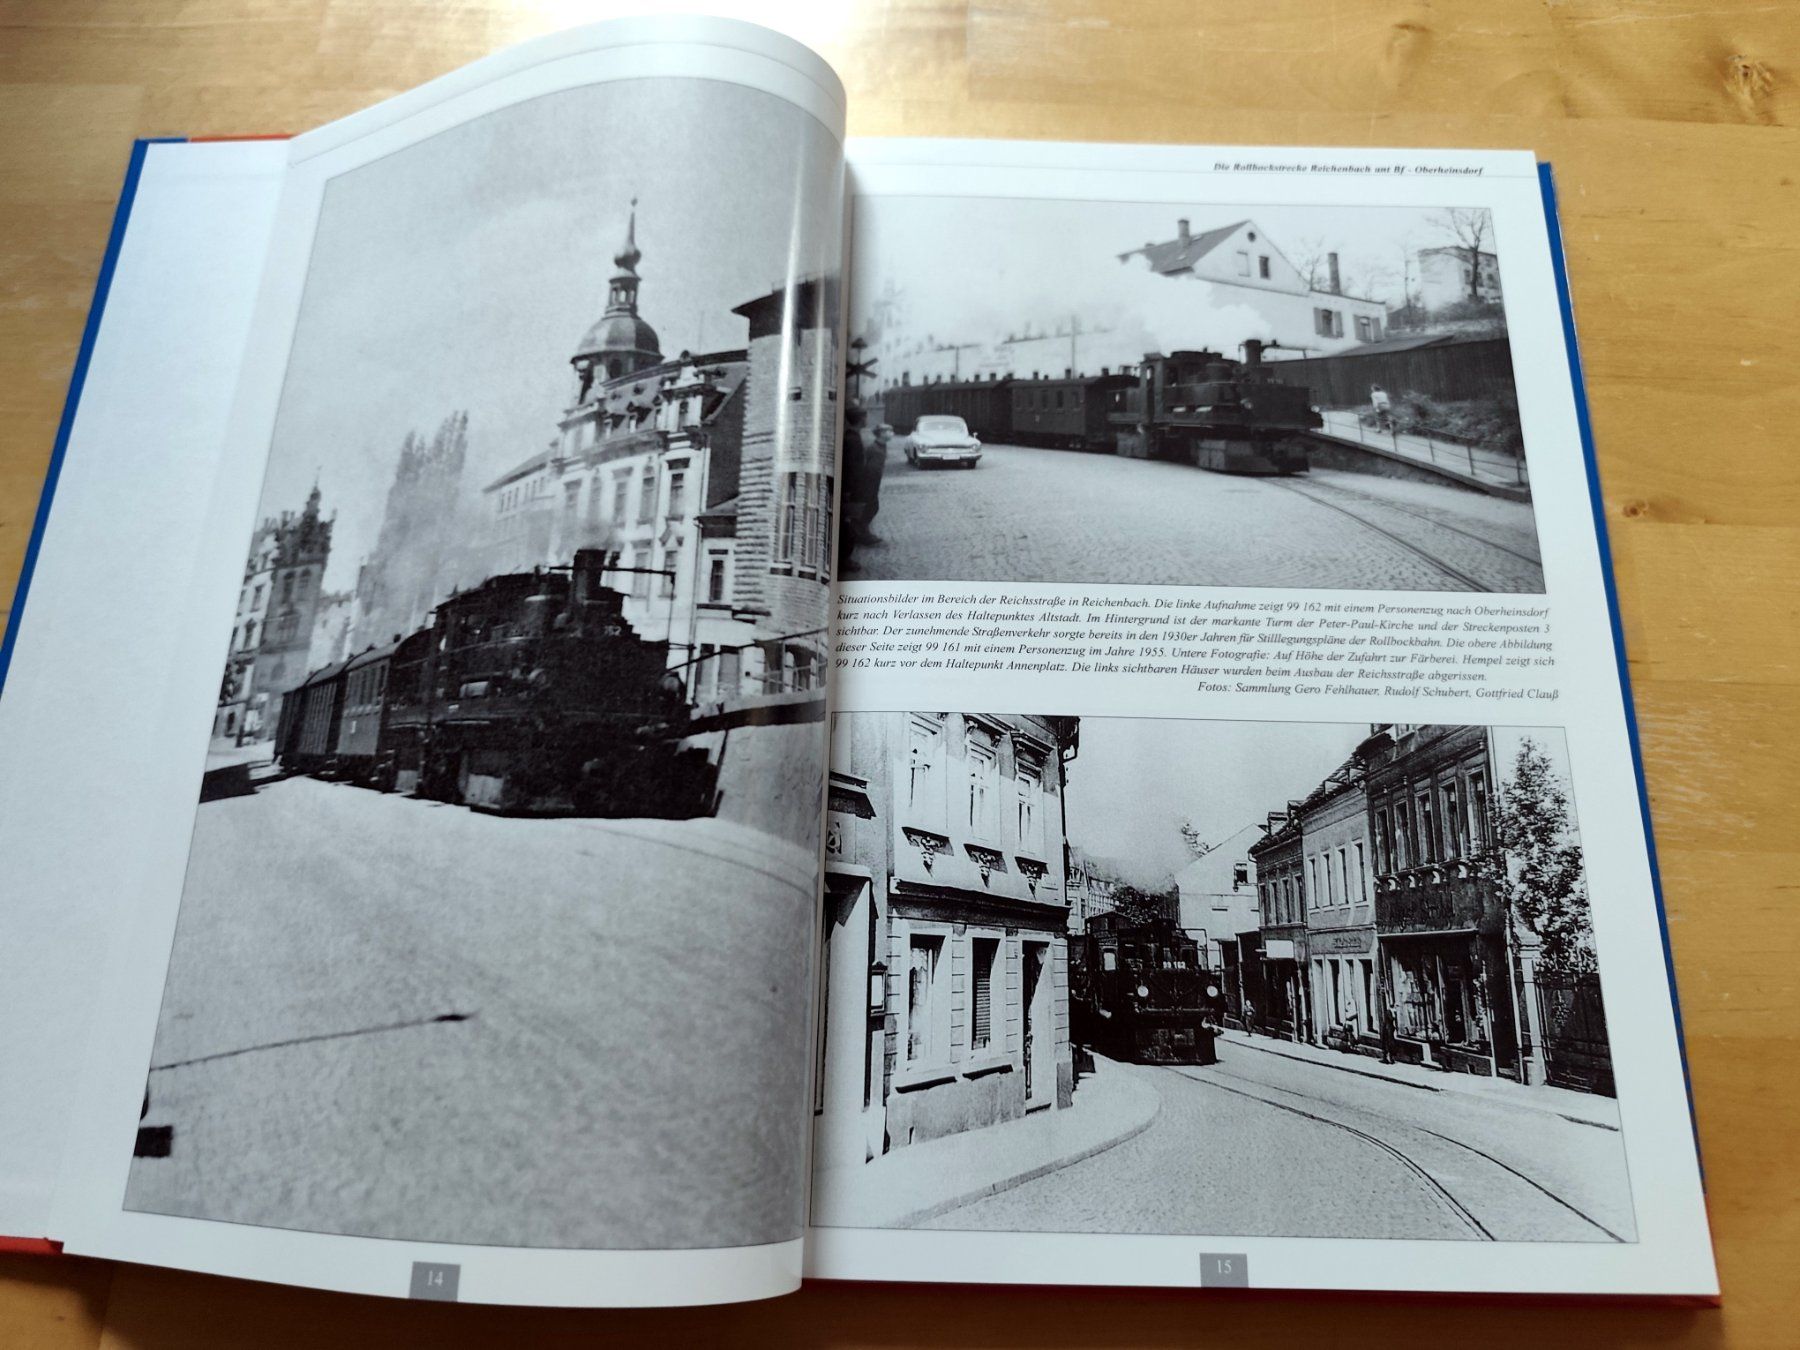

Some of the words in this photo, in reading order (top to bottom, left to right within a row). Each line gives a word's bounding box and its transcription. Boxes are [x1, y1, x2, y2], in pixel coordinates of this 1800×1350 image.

[1213, 162, 1230, 171] Die
[1233, 163, 1307, 172] Rollbockstrecke
[1310, 164, 1371, 172] Reichenbach
[1393, 165, 1405, 174] Bf
[1414, 166, 1483, 175] Oberheinsdorf
[837, 593, 918, 604] Situationsbilder
[921, 594, 934, 603] im
[937, 594, 976, 604] Bereich
[978, 594, 996, 604] der
[999, 595, 1065, 607] Reichsstraße
[1068, 597, 1079, 606] in
[1081, 597, 1150, 607] Reichenbach.
[1154, 598, 1173, 608] Die
[1175, 599, 1201, 609] linke
[1203, 600, 1256, 611] Aufnahme
[1258, 602, 1284, 613] zeigt
[1286, 602, 1300, 610] 99
[1303, 602, 1322, 612] 162
[1324, 604, 1341, 612] mit
[1377, 604, 1443, 616] Personenzug
[1446, 606, 1471, 615] nach
[1474, 606, 1549, 617] Oberheinsdorf
[836, 610, 859, 620] kurz
[863, 609, 888, 619] nach
[893, 609, 941, 619] Verlassen
[945, 610, 963, 620] des
[967, 610, 1034, 622] Haltepunktes
[1038, 612, 1081, 622] Altstadt.
[1086, 613, 1100, 622] Im
[1104, 613, 1170, 625] Hintergrund
[1173, 615, 1186, 624] ist
[1189, 615, 1208, 625] der
[1211, 617, 1261, 626] markante
[1266, 617, 1293, 627] Turm
[1296, 618, 1315, 628] der
[1318, 618, 1413, 630] Peter-Paul-Kirche
[1418, 621, 1438, 630] und
[1441, 621, 1459, 631] der
[1462, 622, 1539, 633] Streckenposten
[1544, 623, 1550, 634] 3
[835, 626, 878, 636] sichtbar.
[883, 625, 903, 635] Der
[905, 626, 969, 636] zunehmende
[972, 626, 1050, 638] Straßenverkehr
[1052, 631, 1085, 640] sorgte
[1088, 629, 1122, 639] bereits
[1126, 630, 1136, 640] in
[1138, 630, 1158, 640] den
[1162, 631, 1198, 641] 1930er
[1199, 632, 1236, 642] Jahren
[1236, 632, 1255, 644] für
[1257, 633, 1346, 646] Stilllegungspläne
[1348, 635, 1367, 645] der
[1369, 636, 1441, 646] Rollbockbahn.
[1446, 637, 1465, 648] Die
[1467, 638, 1497, 648] obere
[1499, 639, 1552, 651] Abbildung
[834, 642, 867, 652] dieser
[869, 641, 895, 651] Seite
[897, 642, 922, 653] zeigt
[925, 641, 939, 651] 99
[942, 642, 960, 652] 161
[963, 643, 981, 652] mit
[983, 644, 1015, 653] einem
[1018, 644, 1086, 657] Personenzug
[1088, 646, 1102, 655] im
[1104, 646, 1135, 656] Jahre
[1139, 647, 1166, 657] 1955.
[1171, 647, 1207, 658] Untere
[1210, 648, 1269, 661] Fotografie:
[1272, 650, 1294, 662] Auf
[1295, 650, 1324, 660] Höhe
[1326, 651, 1345, 661] der
[1347, 651, 1386, 663] Zufahrt
[1462, 654, 1502, 666] Hempel
[1505, 656, 1530, 668] zeigt
[1534, 656, 1555, 666] sich
[835, 658, 848, 668] 99
[852, 657, 871, 668] 162
[873, 657, 896, 667] kurz
[919, 658, 942, 668] dem
[945, 658, 1003, 670] Haltepunkt
[1006, 661, 1066, 672] Annenplatz.
[1071, 661, 1091, 672] Die
[1094, 662, 1118, 672] links
[1122, 663, 1177, 673] sichtbaren
[1180, 664, 1220, 674] Häuser
[1223, 666, 1262, 676] wurden
[1265, 666, 1291, 676] beim
[1293, 667, 1333, 677] Ausbau
[1336, 668, 1354, 678] der
[1357, 668, 1424, 680] Reichsstraße
[1427, 671, 1487, 682] abgerissen.
[1197, 681, 1231, 692] Fotos:
[1235, 682, 1291, 695] Sammlung
[1294, 683, 1321, 694] Gero
[1324, 684, 1379, 695] Fehlhauer,
[1384, 685, 1420, 698] Rudolf
[1475, 687, 1524, 699] Gottfried
[1526, 688, 1559, 700] Clauß
[428, 1270, 444, 1286] 14
[1217, 1264, 1232, 1278] 15
